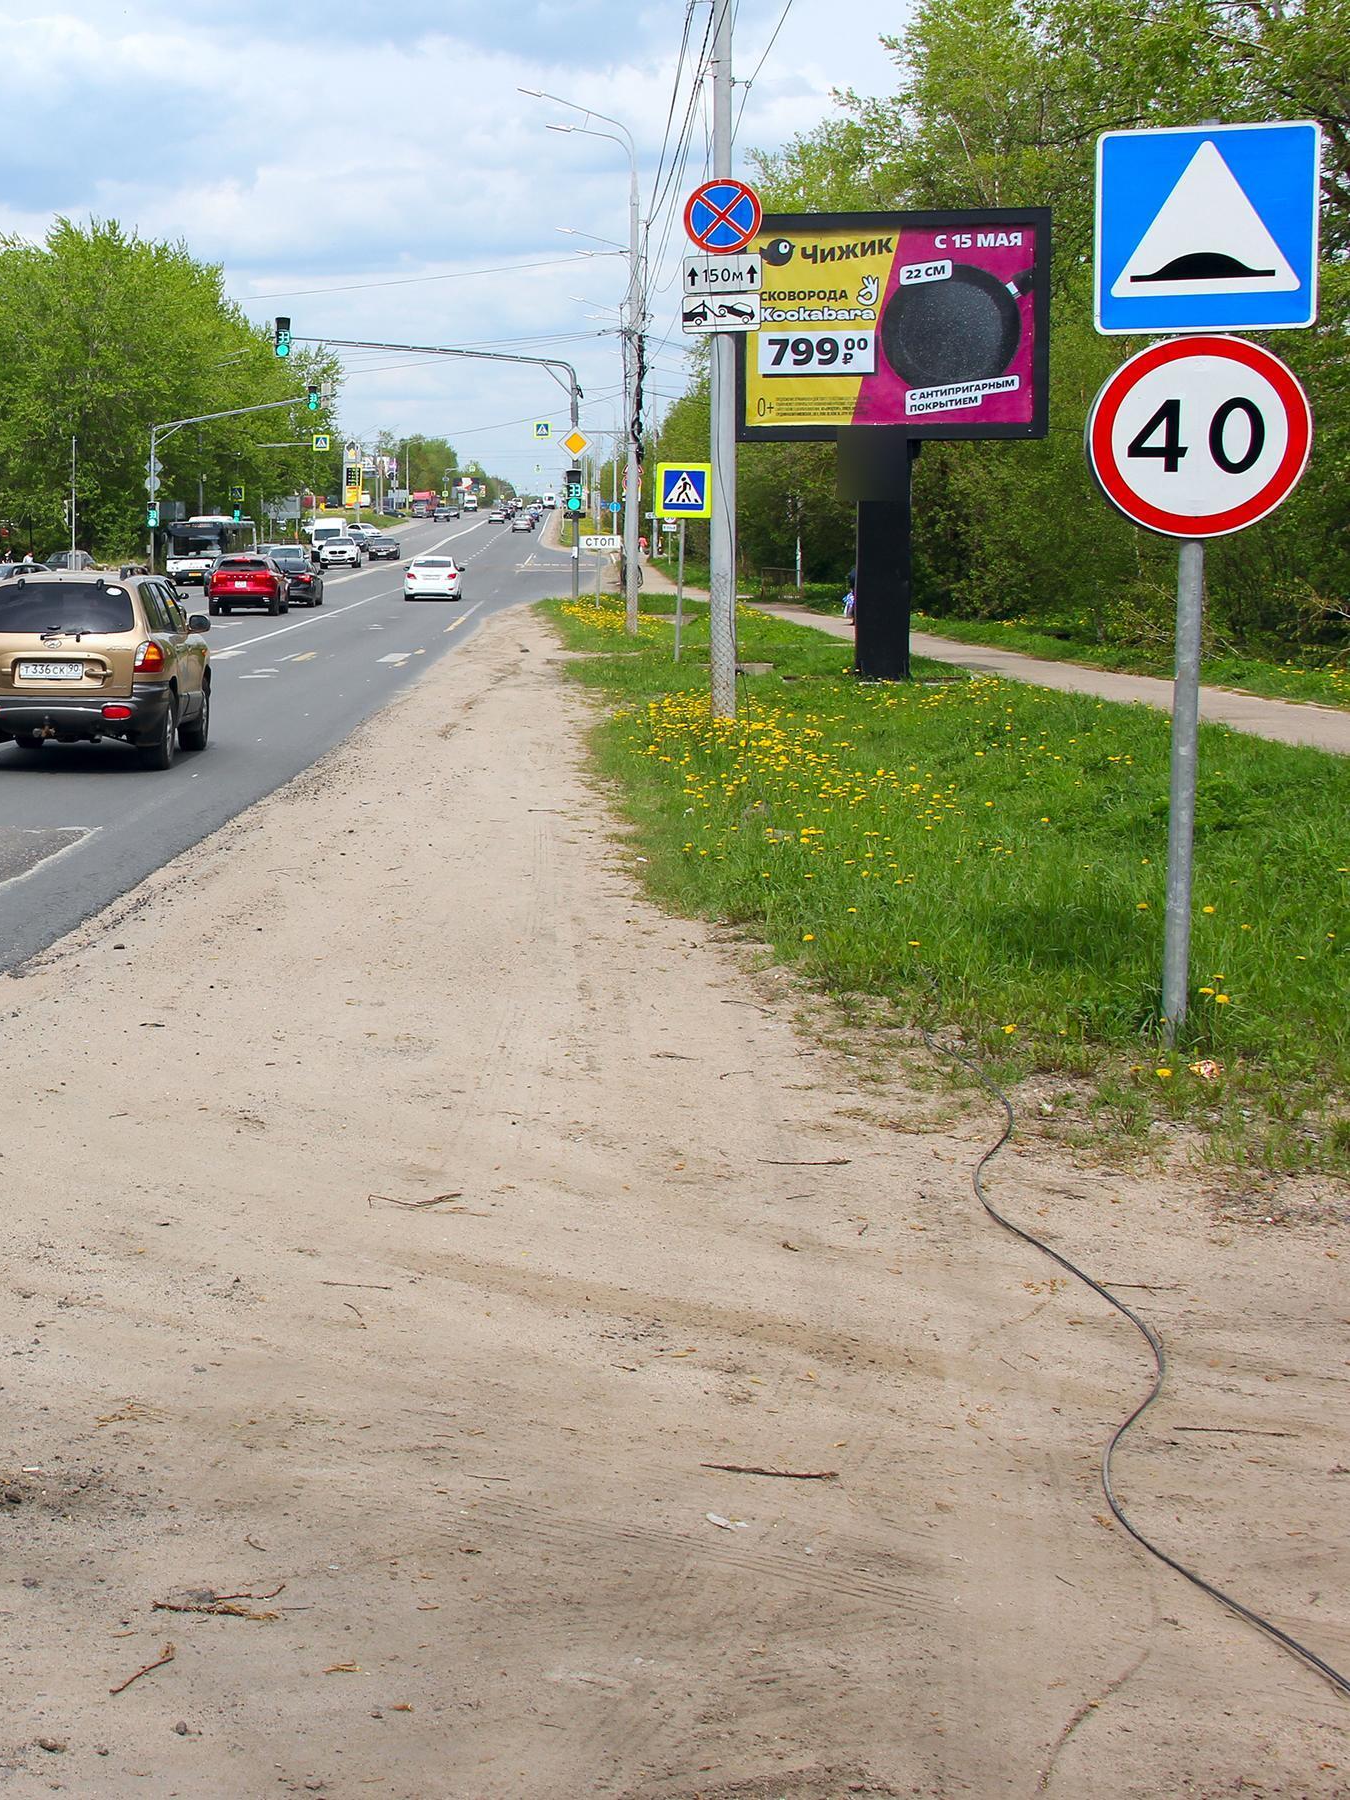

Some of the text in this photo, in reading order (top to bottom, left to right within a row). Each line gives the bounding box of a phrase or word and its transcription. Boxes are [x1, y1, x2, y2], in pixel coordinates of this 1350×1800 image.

[934, 232, 1023, 249] С 15 МАЯ
[800, 237, 894, 265] ЧИЖИК
[905, 264, 946, 280] 22 СМ
[760, 289, 848, 302] СКОВОРОДА
[760, 305, 877, 323] Kookabara
[767, 336, 840, 367] 799
[909, 379, 1015, 401] С АНТИПРИГАРНЫМ
[756, 396, 775, 417] 0+
[909, 395, 978, 413] ПОКРЫТИЕМ
[1127, 396, 1266, 475] 40
[585, 537, 615, 547] СТОП
